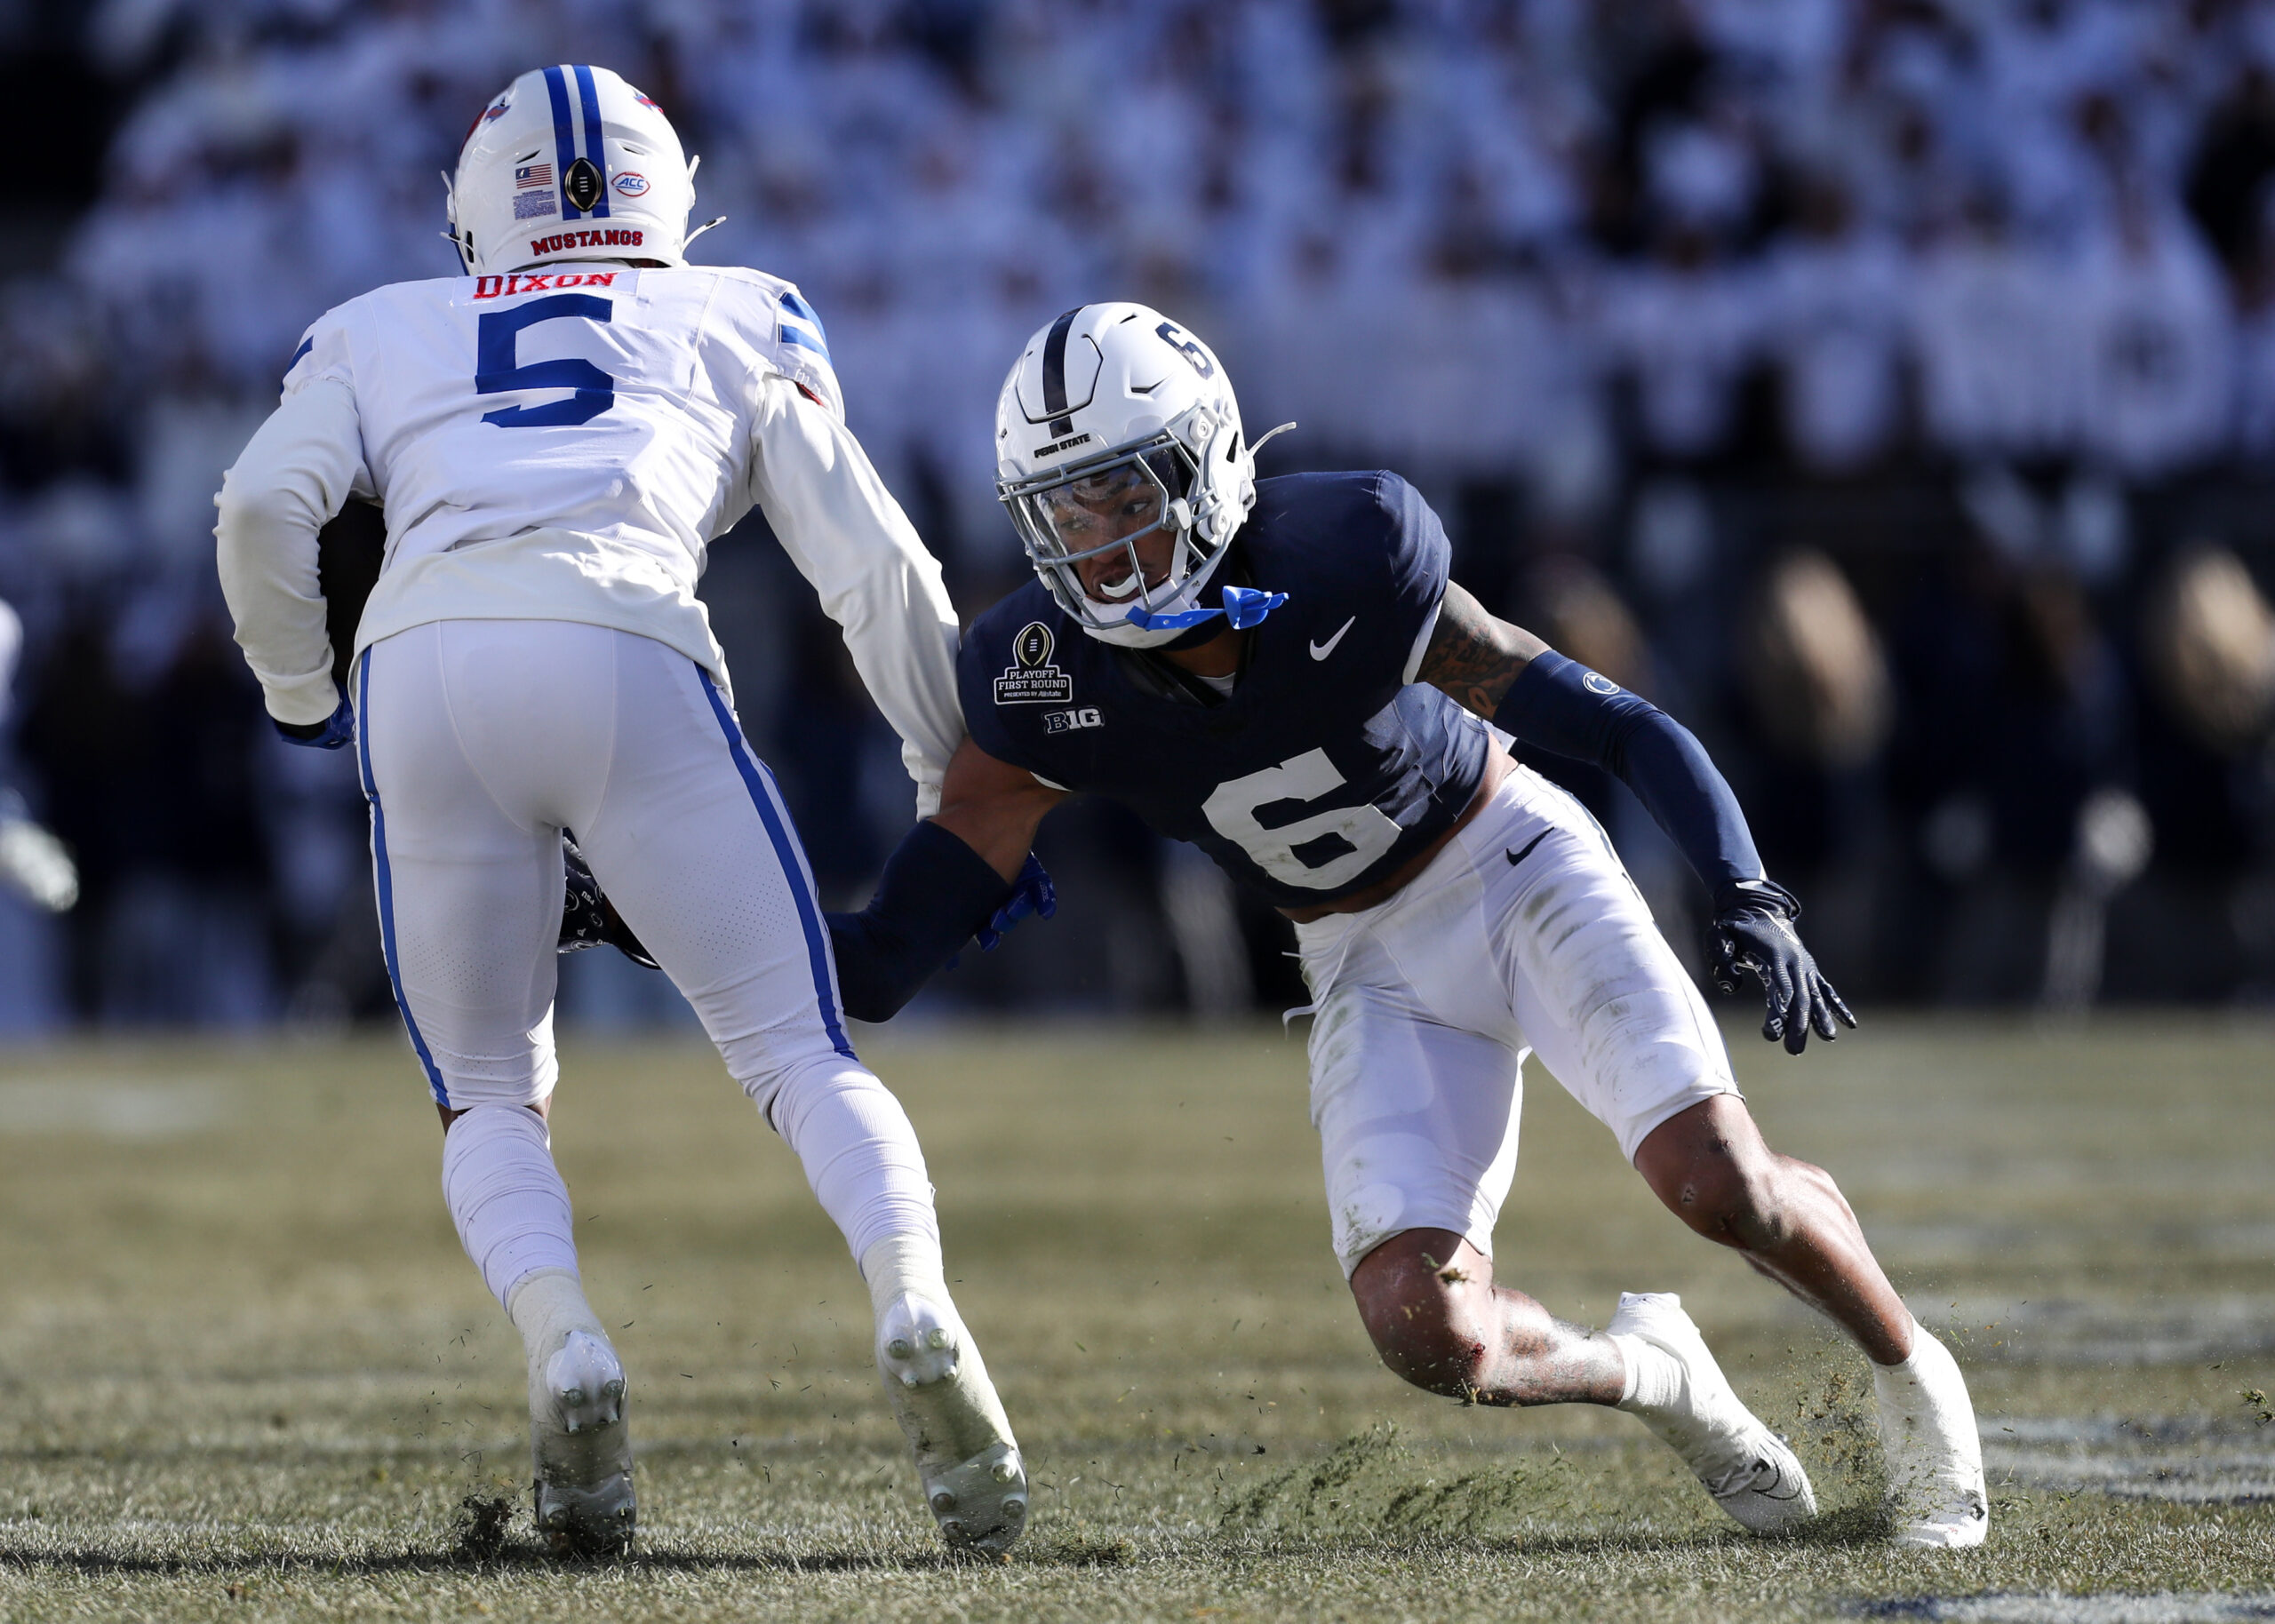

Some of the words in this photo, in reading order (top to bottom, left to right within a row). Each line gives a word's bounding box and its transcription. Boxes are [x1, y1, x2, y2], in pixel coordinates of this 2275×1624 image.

[618, 178, 644, 187] ACC
[531, 229, 643, 257] MUSTANGS
[474, 272, 619, 299] DIXON
[475, 293, 615, 428] 5
[1155, 322, 1215, 380] 6
[1034, 442, 1059, 458] PENN
[1059, 433, 1091, 450] STATE
[998, 681, 1028, 690] FIRST
[1031, 679, 1067, 689] ROUND
[1010, 669, 1055, 680] PLAYOFF
[1201, 746, 1402, 889] 6
